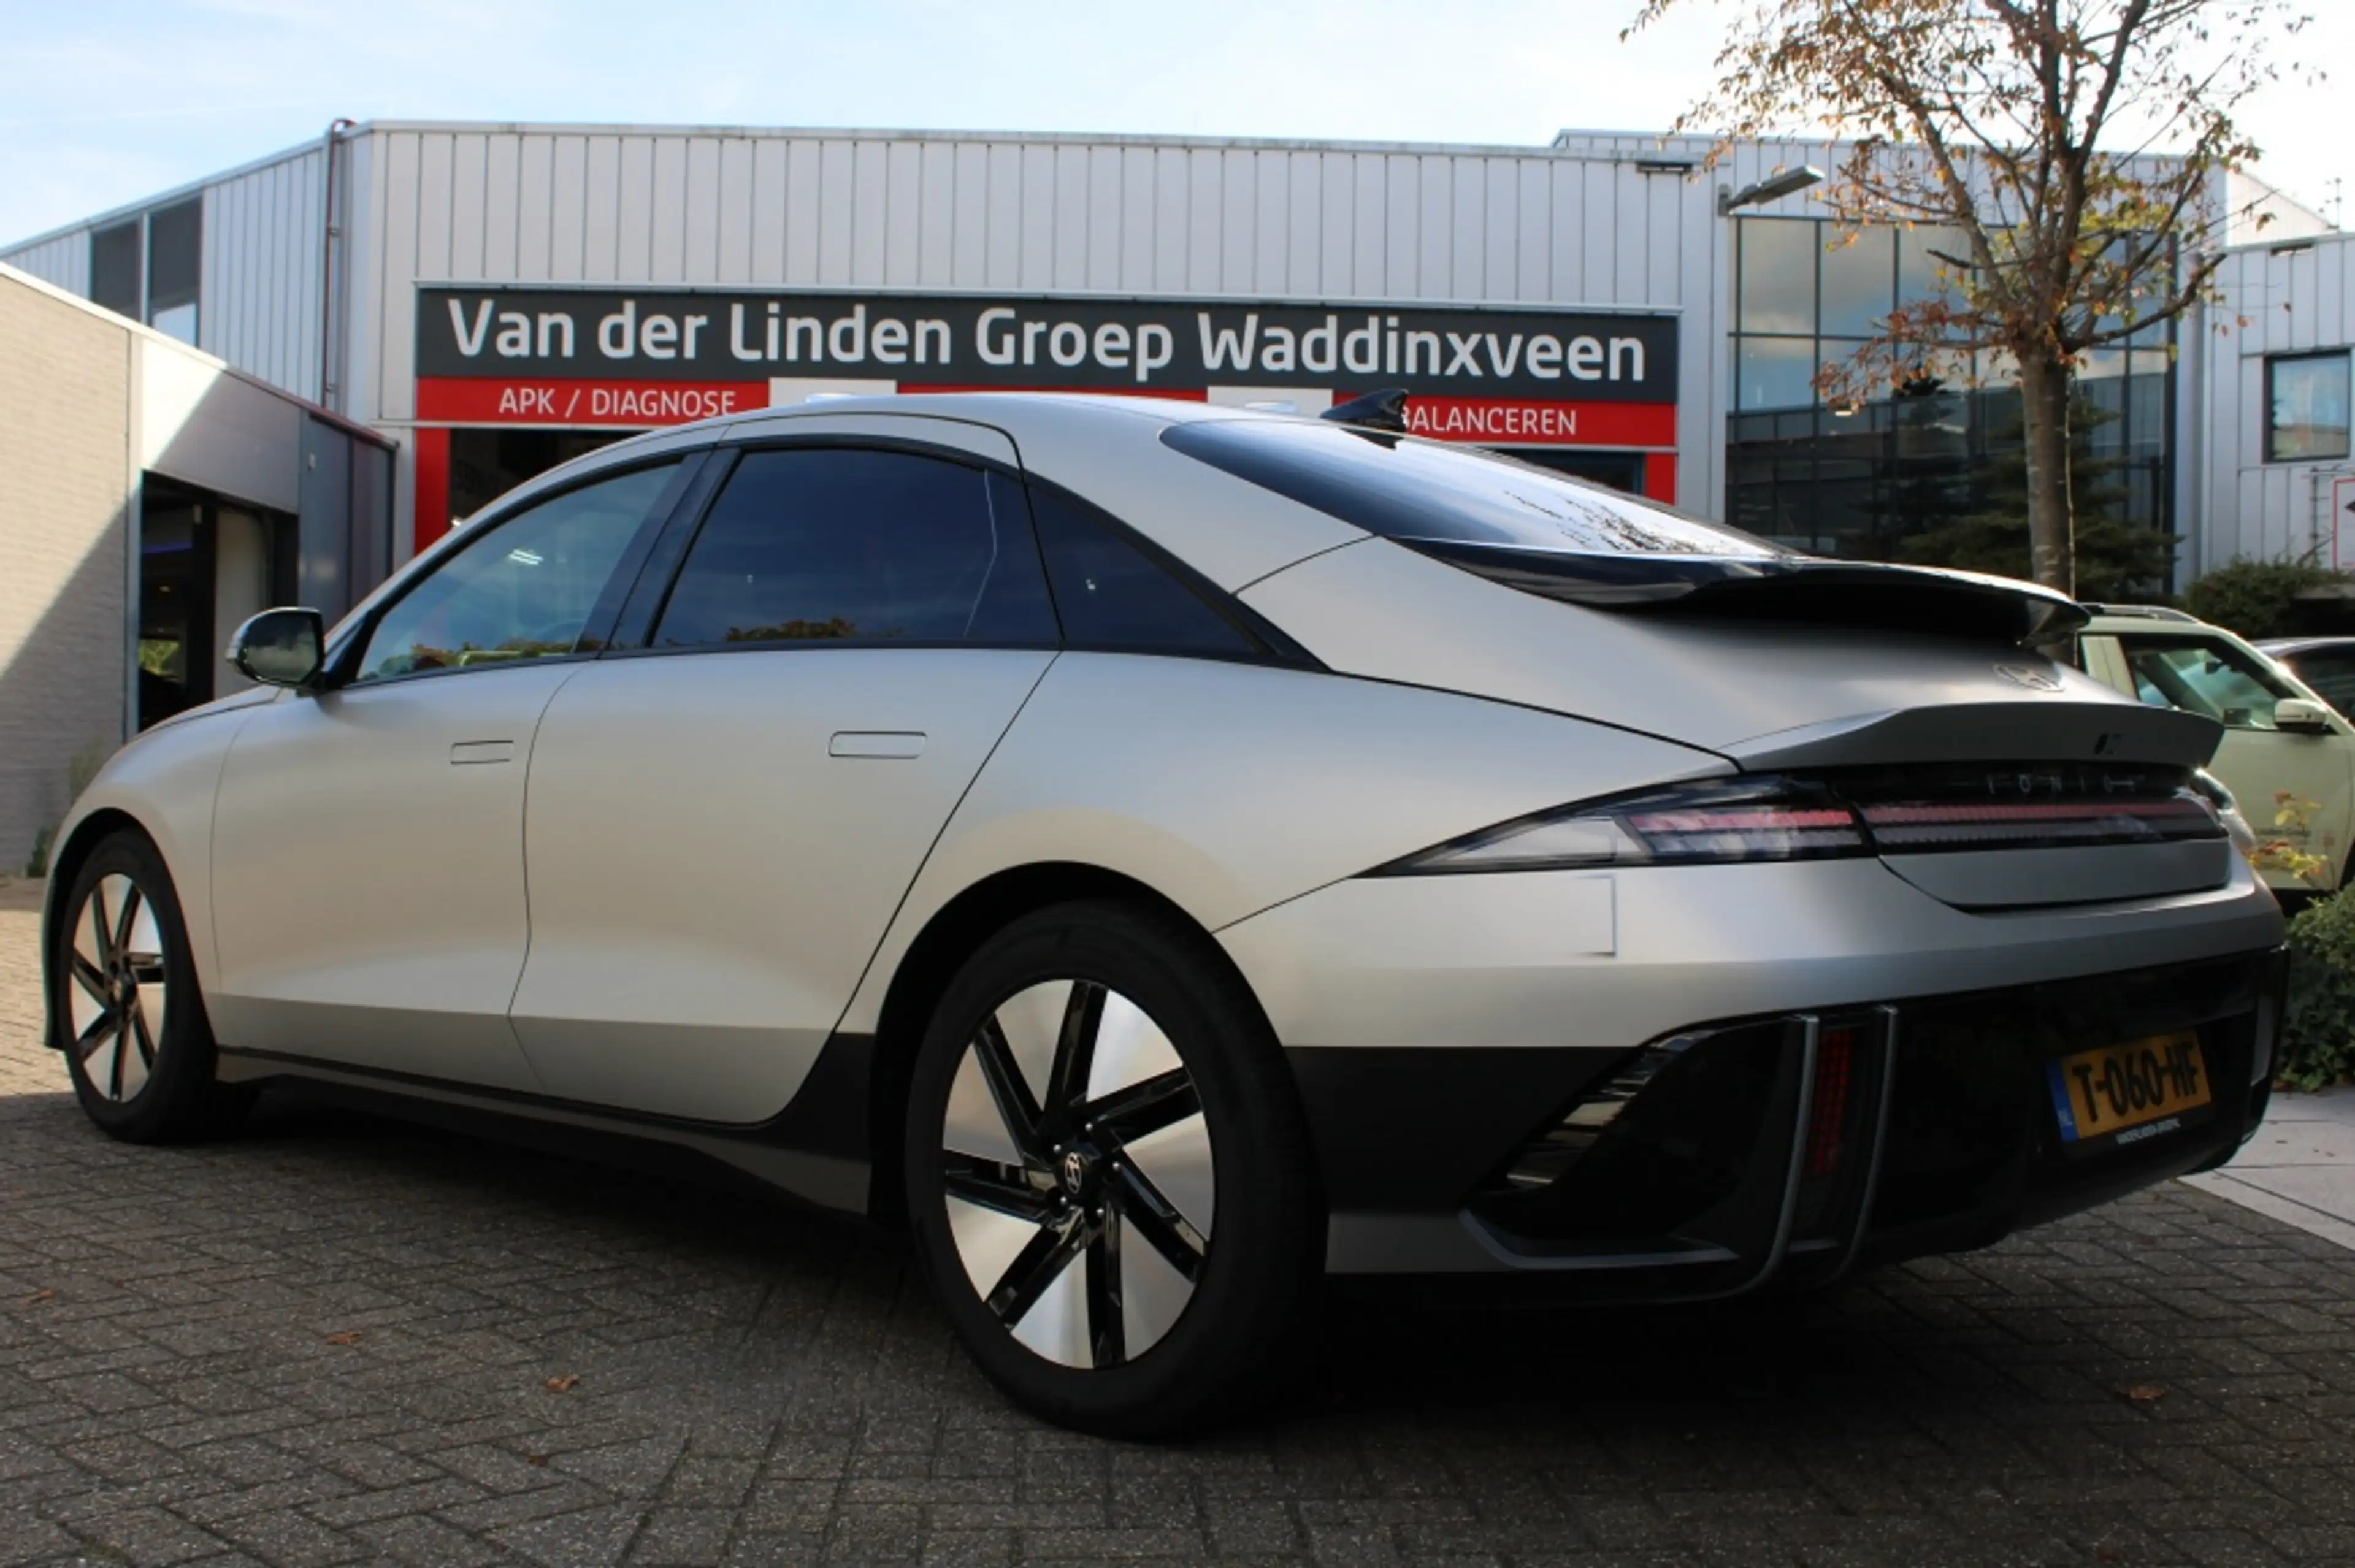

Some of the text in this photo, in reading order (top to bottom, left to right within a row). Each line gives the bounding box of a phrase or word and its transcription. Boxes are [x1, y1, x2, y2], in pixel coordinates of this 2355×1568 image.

[448, 299, 1646, 381] Van der Linden Groep Waddinxveen
[499, 388, 554, 414] APK
[591, 389, 735, 416] DIAGNOSE
[2071, 1041, 2198, 1123] T-060-HF
